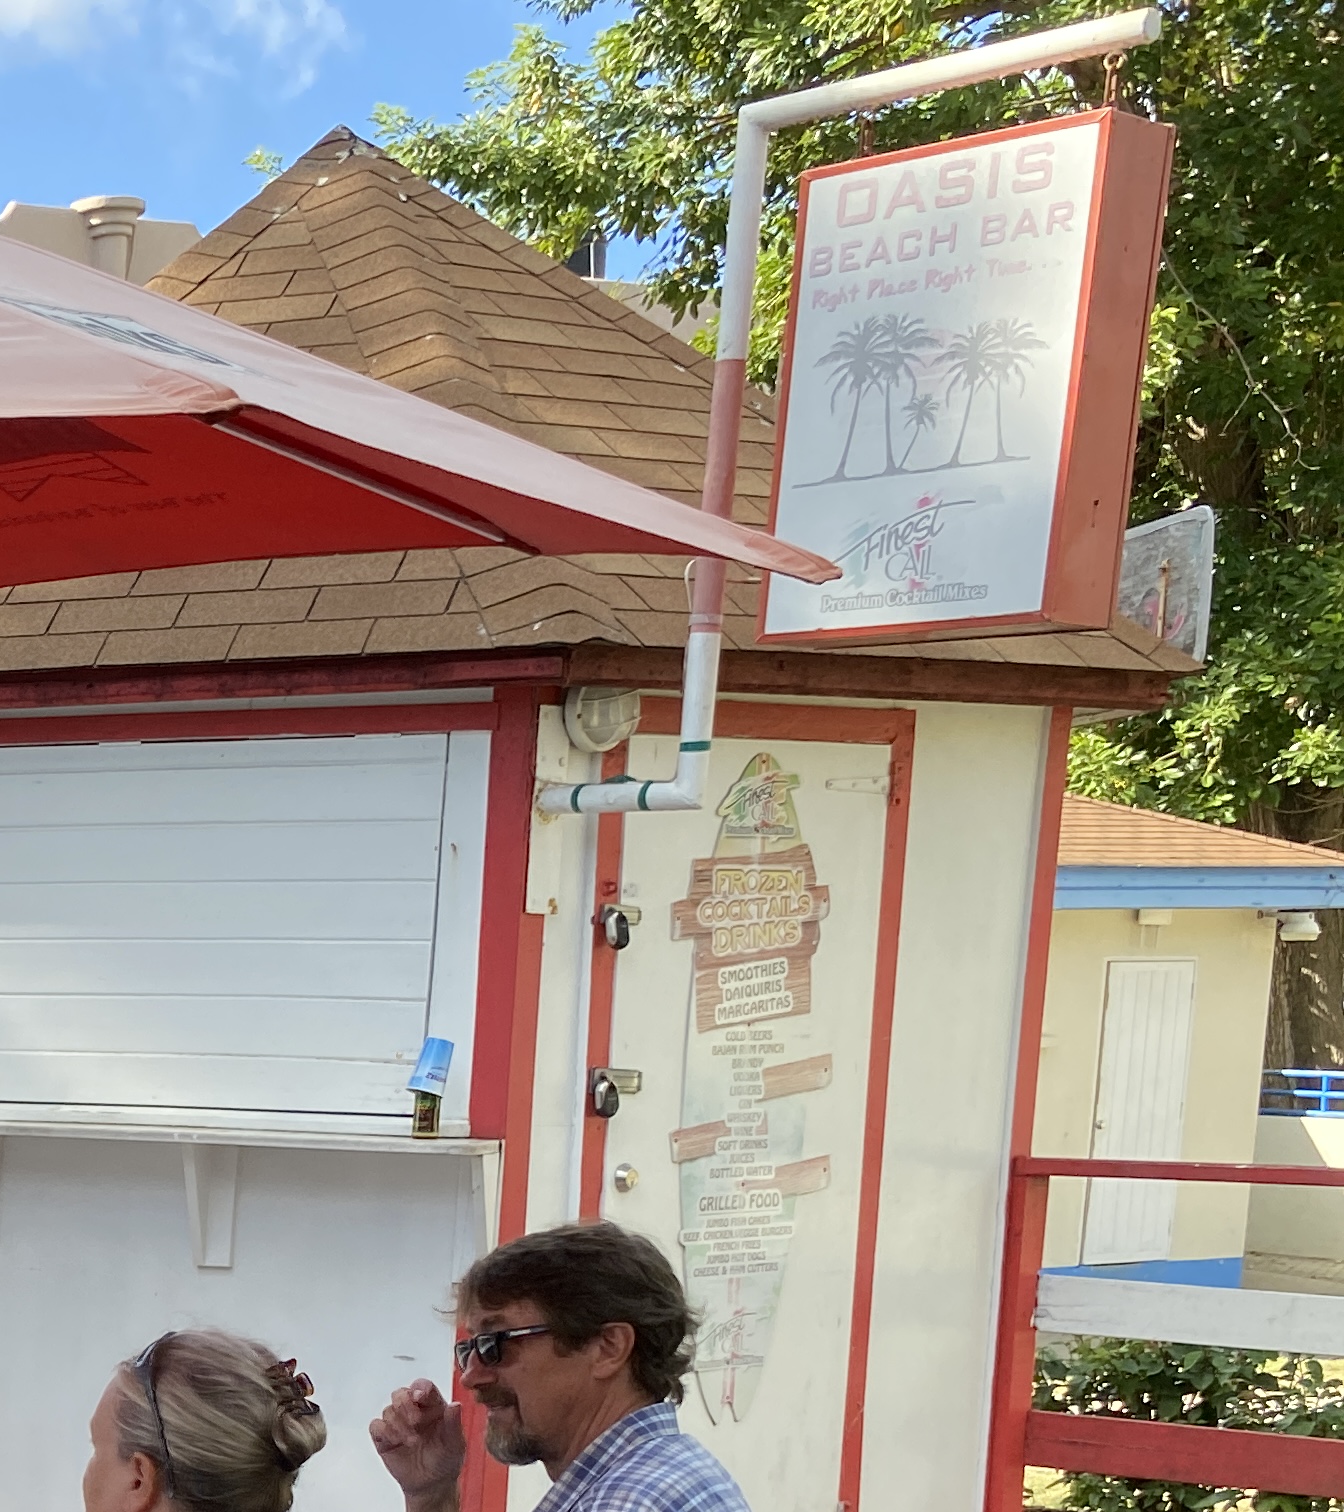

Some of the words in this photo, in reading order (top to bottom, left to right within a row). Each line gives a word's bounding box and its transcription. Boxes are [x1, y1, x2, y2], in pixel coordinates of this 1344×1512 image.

[836, 142, 1055, 229] OASIS
[808, 223, 957, 279] BEACH
[979, 201, 1075, 247] BAR
[811, 284, 860, 312] Right
[866, 274, 918, 300] Place
[925, 264, 977, 293] Right
[849, 500, 960, 571] Finest
[885, 544, 936, 583] CALL
[820, 592, 884, 613] Premium
[885, 583, 943, 608] Cocktail
[943, 582, 989, 601] Mixes
[714, 868, 804, 898] FROZEN
[697, 894, 812, 924] COCKTAILS
[713, 920, 801, 955] DRINKS
[720, 960, 787, 985] SMOOTHIES
[724, 979, 784, 1003] DAIQUIRIS
[717, 995, 792, 1021] MARGARITAS
[717, 1140, 738, 1151] SOFT
[739, 1138, 768, 1150] DRINKS
[709, 1167, 745, 1179] BOTTLED
[746, 1165, 773, 1176] WATER
[699, 1194, 746, 1212] GRILLED
[749, 1192, 780, 1208] FOOD
